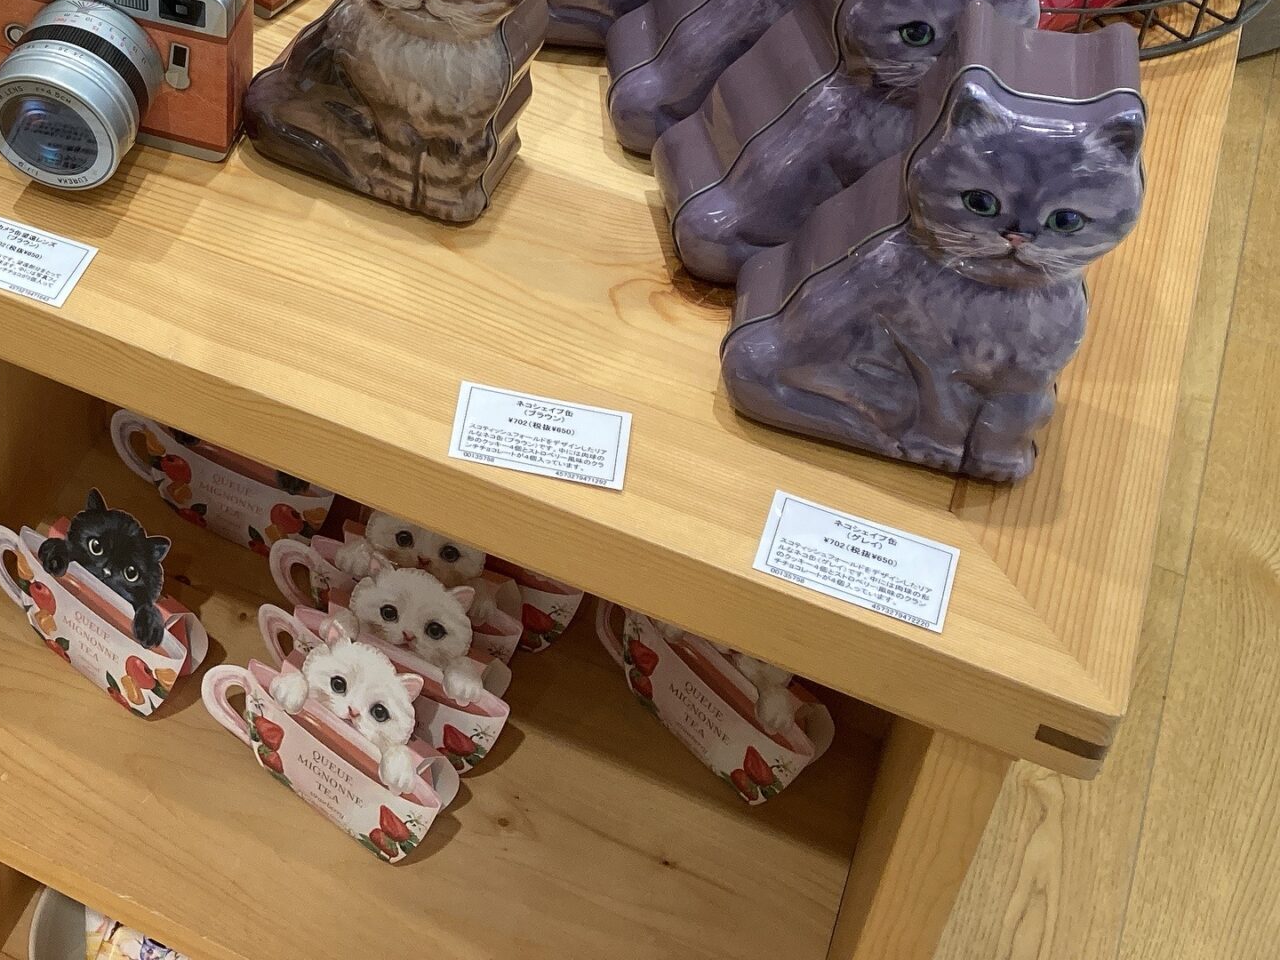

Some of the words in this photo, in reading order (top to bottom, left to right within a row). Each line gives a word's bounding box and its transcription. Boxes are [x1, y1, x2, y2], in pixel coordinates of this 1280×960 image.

[516, 400, 574, 417] ネコシェイプ缶
[523, 409, 566, 423] (ブラウン)
[198, 481, 266, 515] MIGNONNE
[212, 473, 251, 495] QUEUE
[219, 502, 241, 518] TEA
[833, 519, 898, 547] ネコシェイプ缶
[847, 532, 883, 550] (グレイ)
[74, 610, 111, 641] QUEUE
[62, 615, 120, 665] MIGNONNE
[79, 643, 100, 663] TEA
[669, 682, 731, 746] MIGNONNE
[685, 681, 725, 723] QUEUE
[683, 711, 706, 739] TEA
[297, 754, 364, 809] MIGNONNE
[312, 750, 354, 786] QUEUE
[315, 781, 340, 804] TEA
